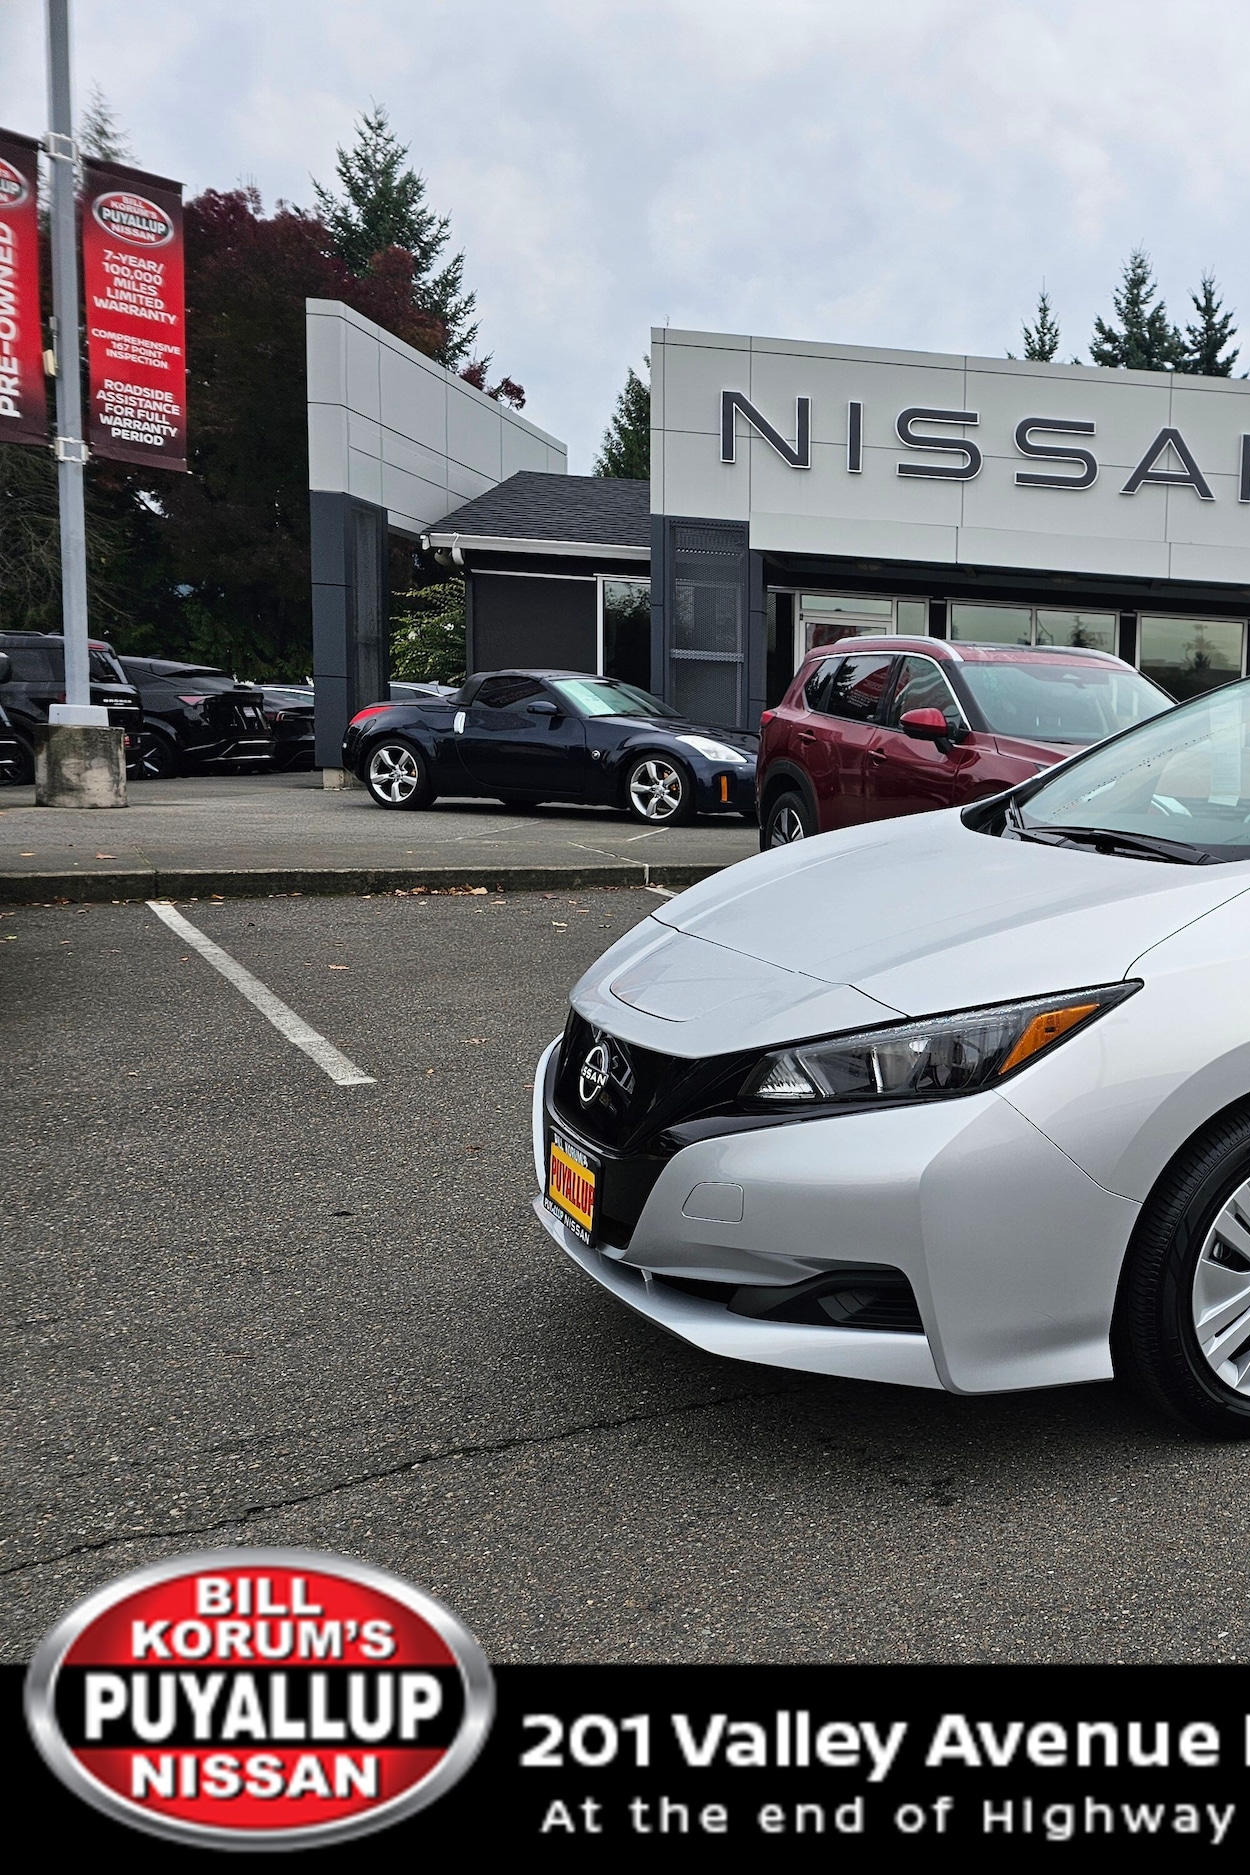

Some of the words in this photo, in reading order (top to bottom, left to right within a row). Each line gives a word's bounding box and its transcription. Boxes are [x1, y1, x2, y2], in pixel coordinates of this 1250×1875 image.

[121, 195, 145, 209] BILL
[101, 206, 167, 235] PUYALLUP
[110, 223, 156, 241] NISSAN
[102, 261, 163, 286] 100,000
[103, 249, 164, 274] 7-YEAR/
[106, 286, 164, 310] LIMITED
[113, 277, 158, 296] MILES
[0, 221, 21, 419] PRE-OWNED
[93, 295, 177, 324] WARRANTY
[91, 328, 181, 355] COMPREHENSIVE
[111, 341, 130, 351] 167
[131, 345, 163, 359] POINT
[106, 348, 168, 369] INSPECTION
[96, 390, 181, 416] ASSISTANCE
[103, 379, 173, 403] ROADSIDE
[99, 413, 177, 437] WARRANTY
[105, 403, 135, 418] FOR
[136, 408, 171, 425] FULL
[111, 427, 164, 446] PERIOD
[551, 1154, 596, 1218] PUYALLUP
[563, 1214, 591, 1246] NISSAN
